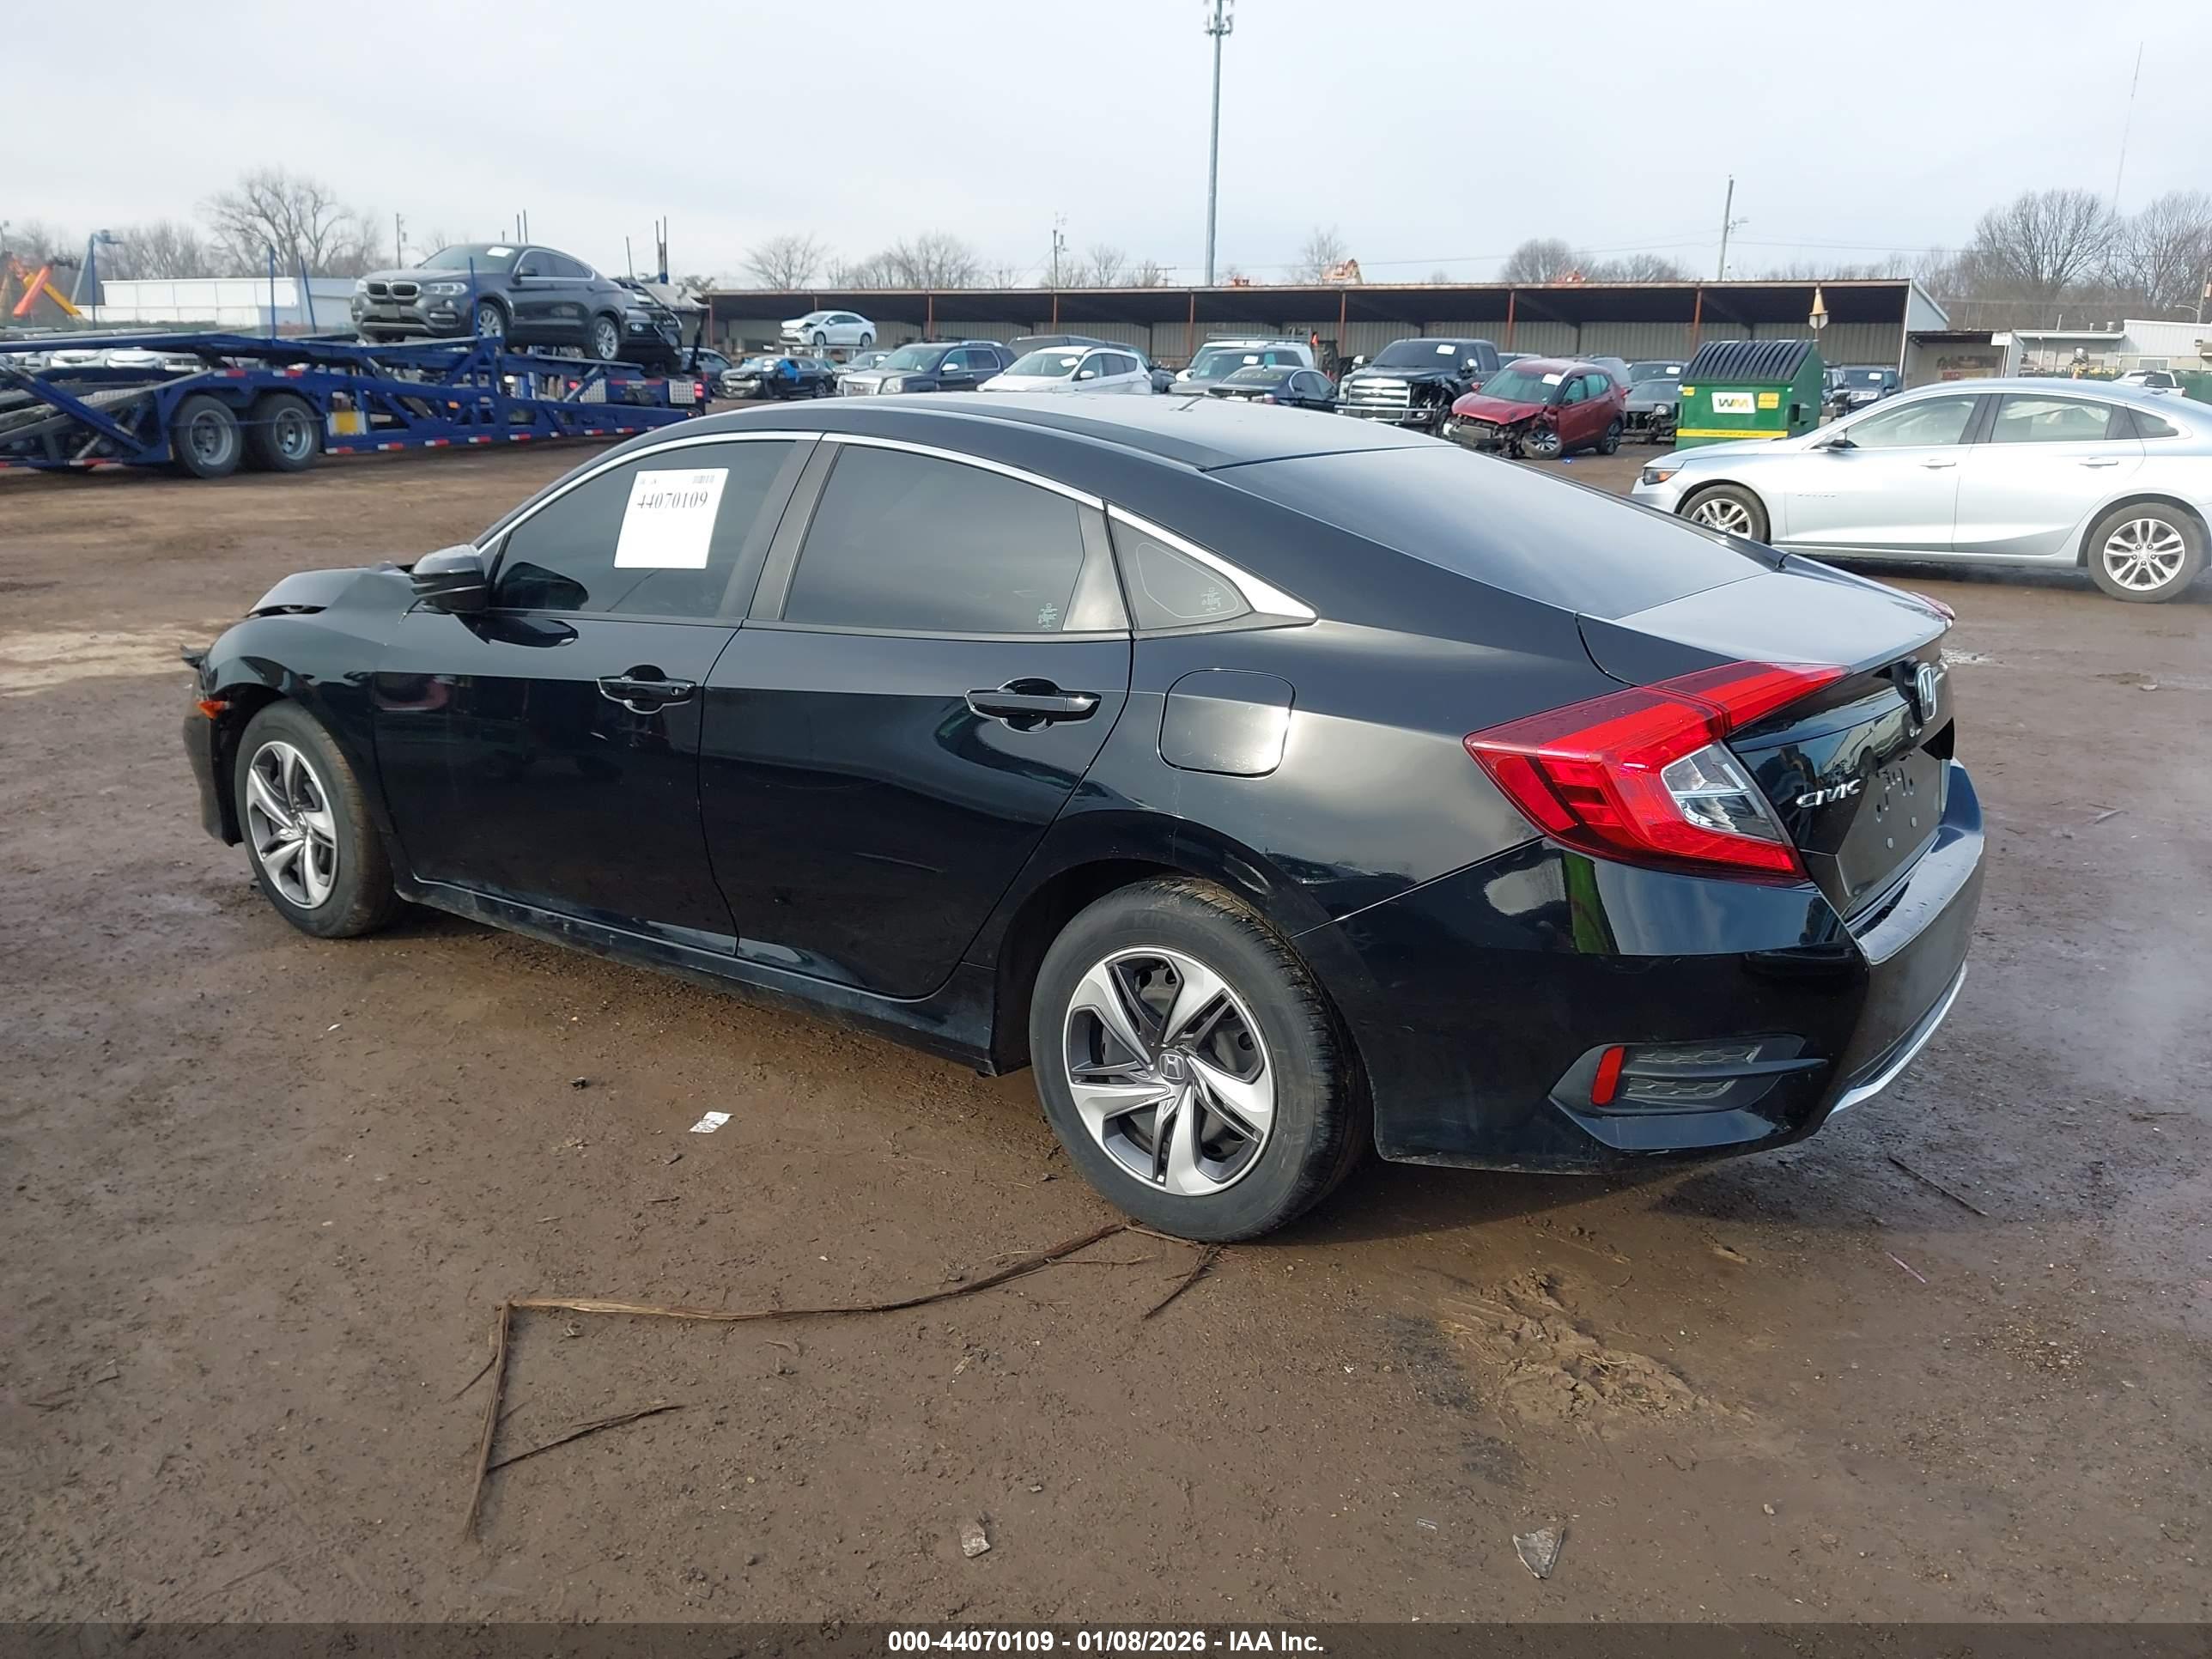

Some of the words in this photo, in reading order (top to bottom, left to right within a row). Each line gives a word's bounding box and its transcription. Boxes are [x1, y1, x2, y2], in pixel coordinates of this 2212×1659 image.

[1718, 398, 1749, 408] WM
[637, 490, 708, 509] 44070109
[1796, 778, 1862, 809] CIVIC
